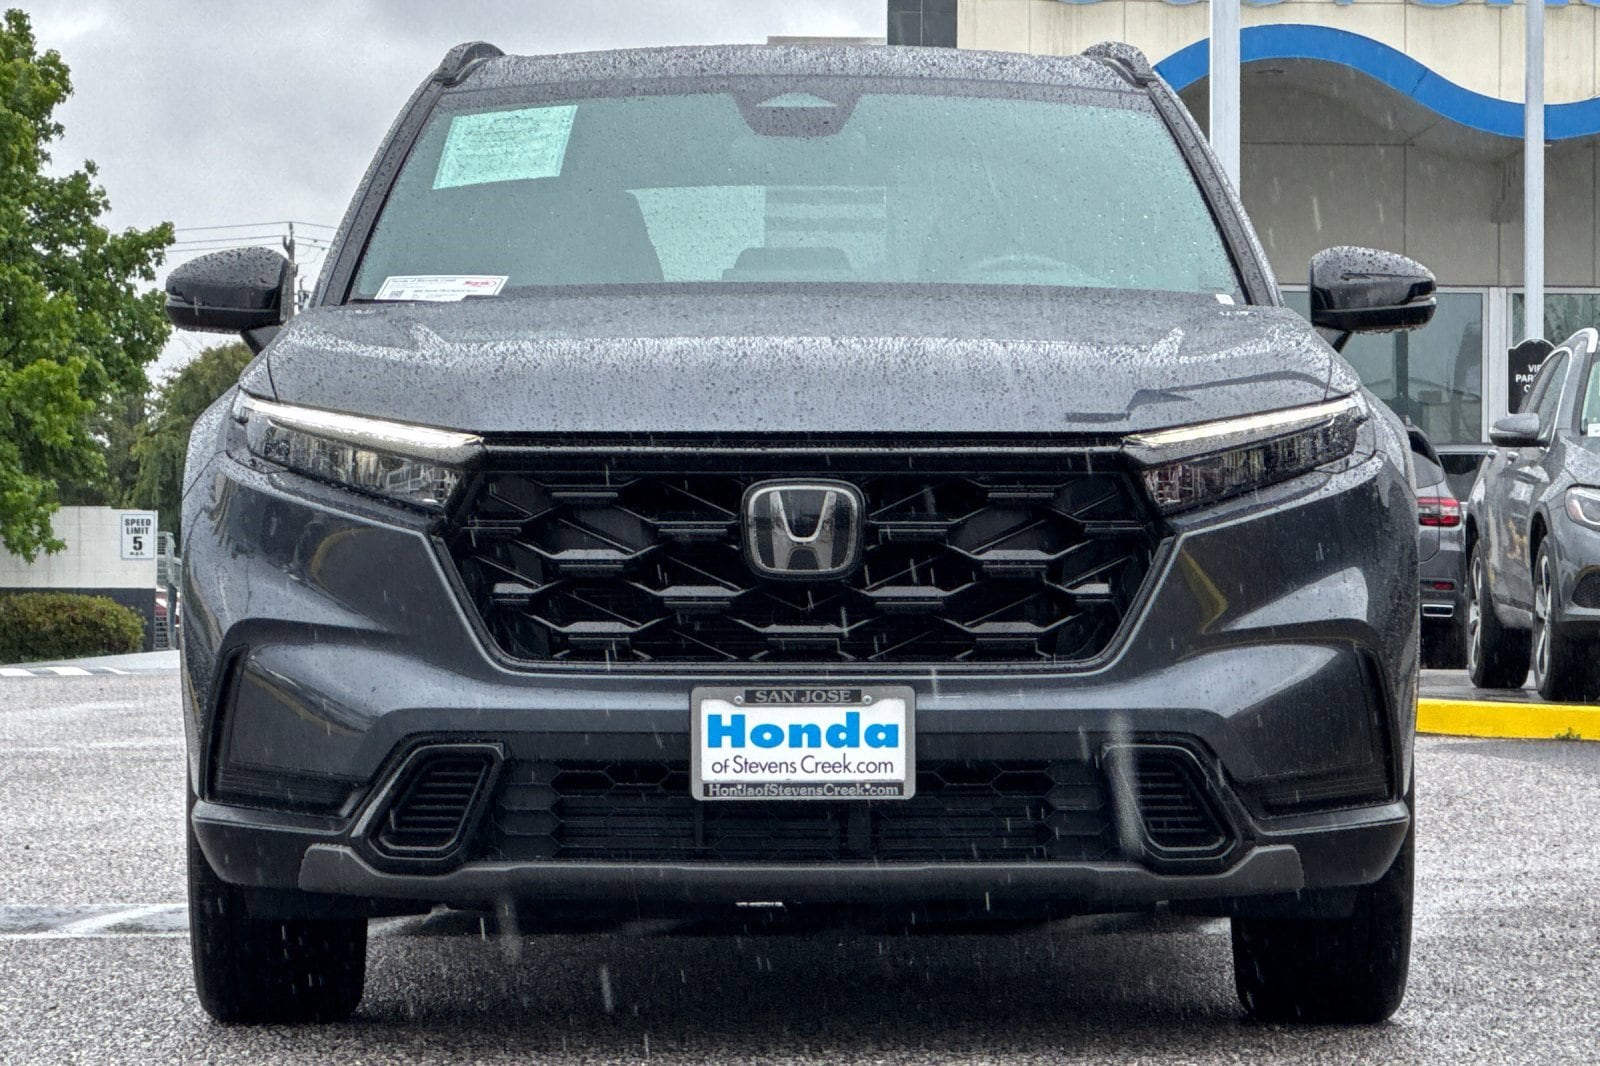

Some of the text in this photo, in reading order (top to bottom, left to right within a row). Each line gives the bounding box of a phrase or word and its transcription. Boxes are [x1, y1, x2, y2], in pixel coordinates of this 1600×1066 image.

[124, 518, 151, 526] SPEED
[126, 527, 149, 535] LIMIT
[132, 536, 143, 551] 5
[755, 690, 852, 703] SAN JOSE
[707, 711, 899, 748] Honda
[711, 752, 894, 774] of Stevens Creek.com
[708, 783, 899, 797] HondaofStevensCreek.com
